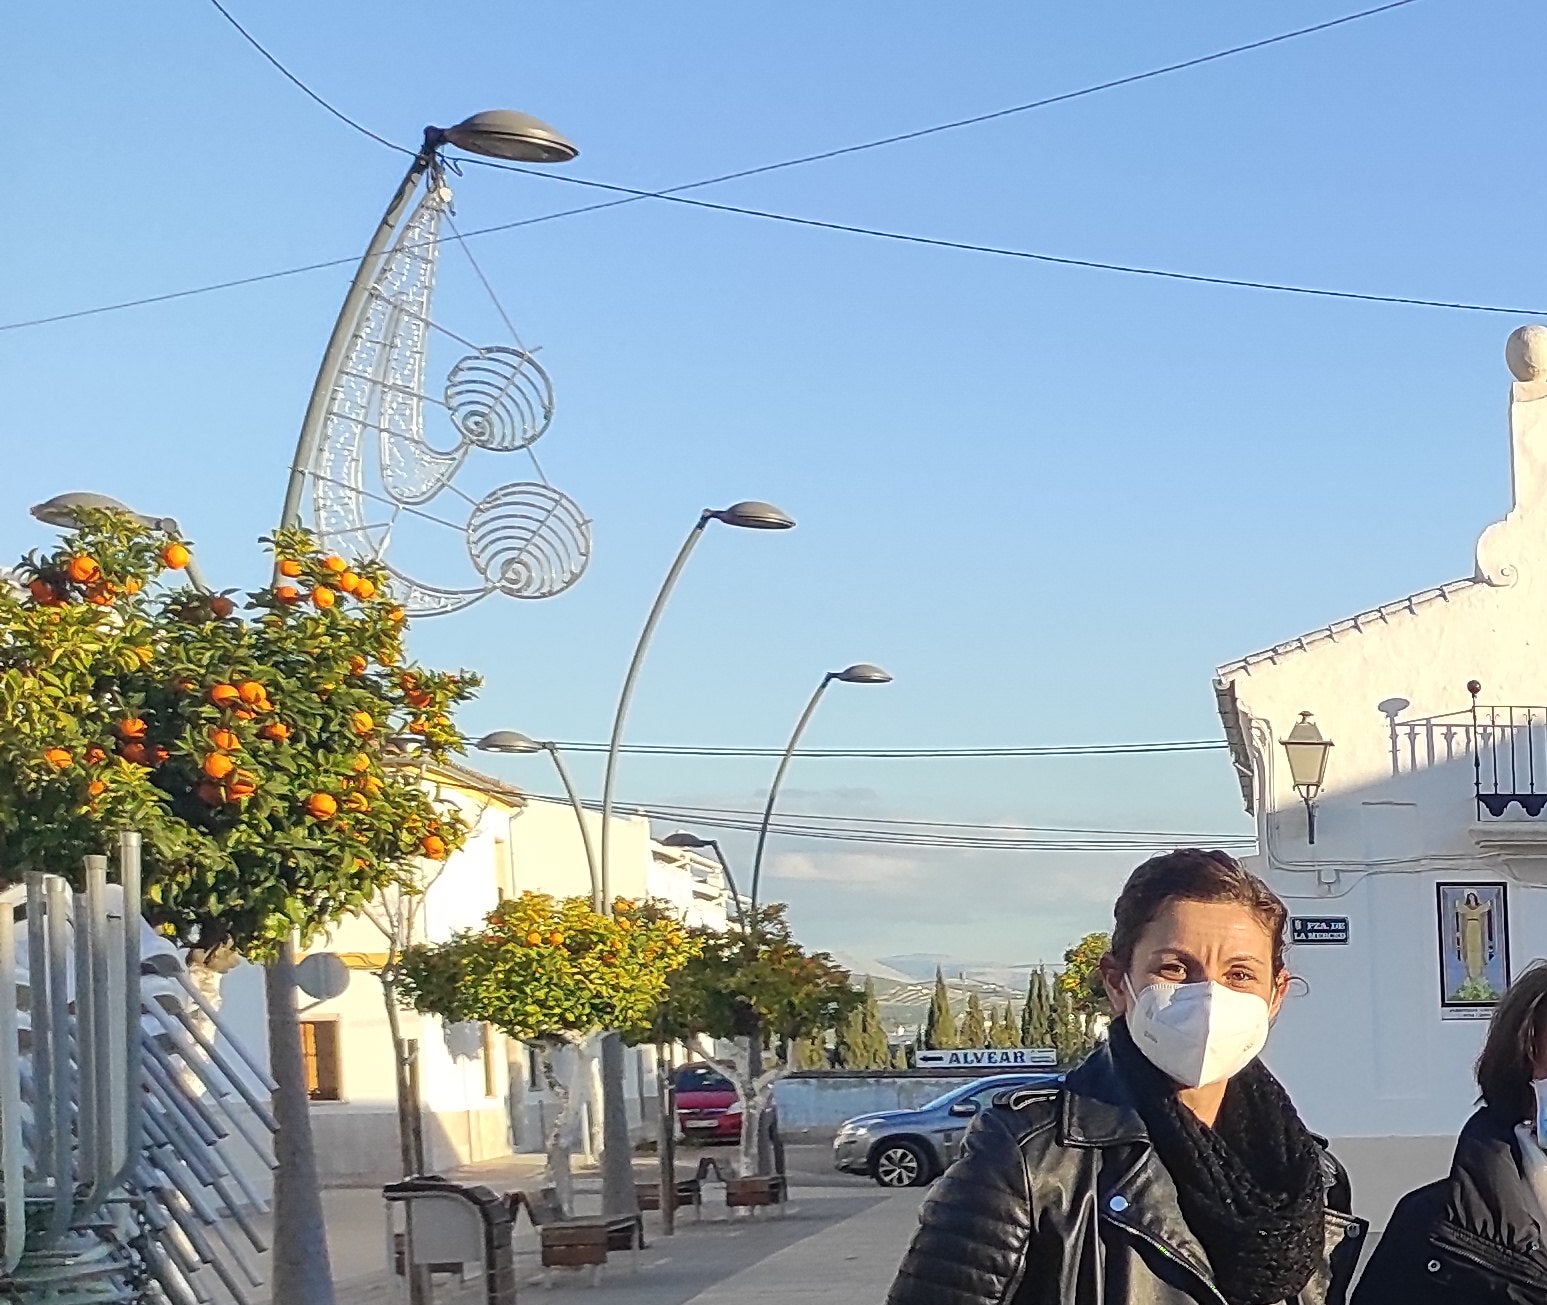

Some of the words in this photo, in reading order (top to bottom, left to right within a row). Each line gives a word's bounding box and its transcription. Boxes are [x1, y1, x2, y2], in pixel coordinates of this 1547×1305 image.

[1330, 922, 1346, 930] DE
[1294, 932, 1306, 940] LA
[1308, 932, 1346, 940] MERCED
[949, 1051, 1026, 1064] ALVEAR
